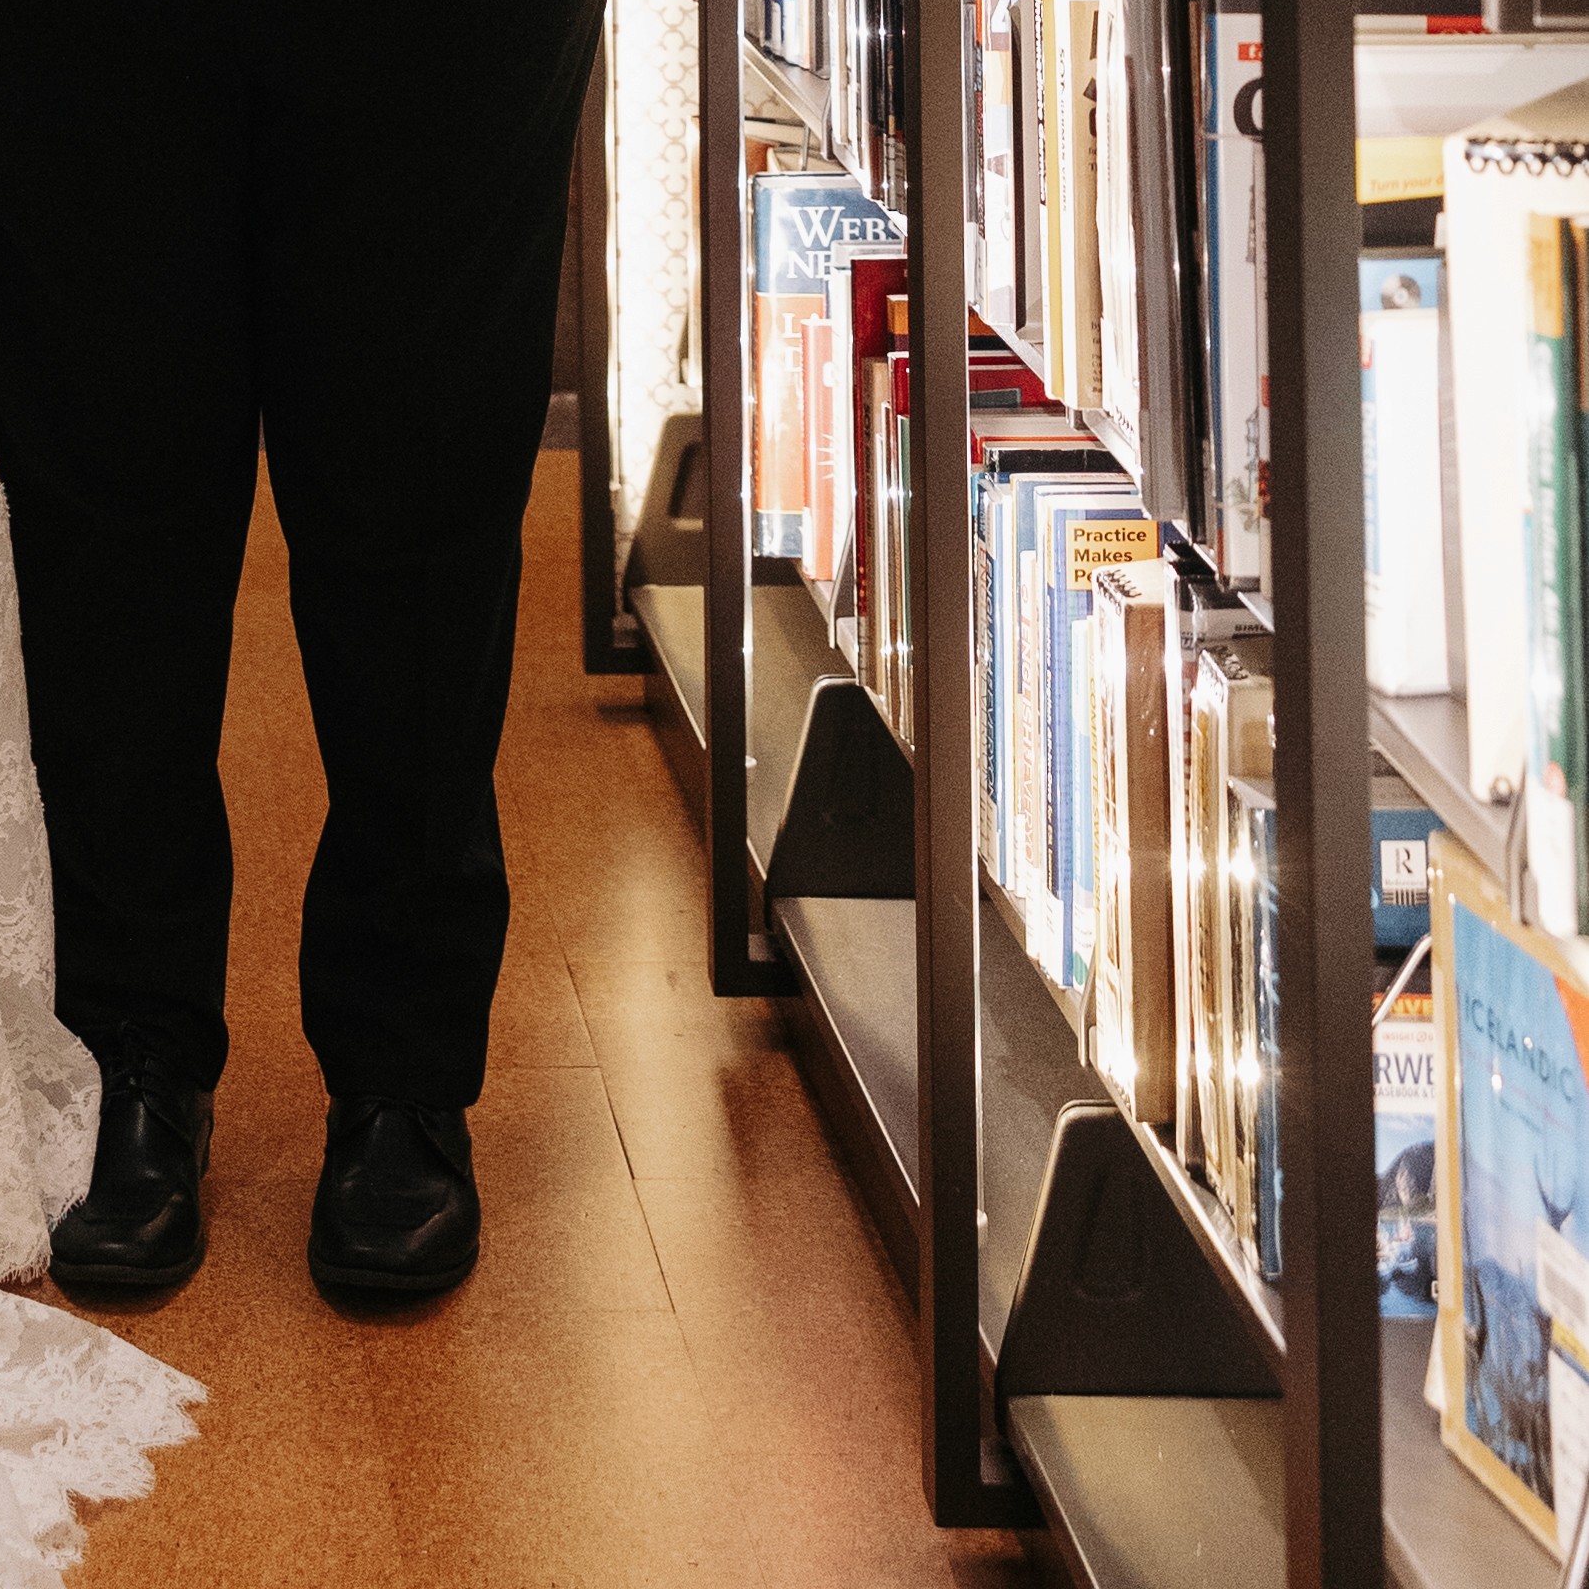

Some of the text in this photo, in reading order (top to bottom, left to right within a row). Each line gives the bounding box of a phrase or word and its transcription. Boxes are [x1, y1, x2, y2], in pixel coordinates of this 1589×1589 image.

[1073, 527, 1147, 543] Practice
[1073, 548, 1133, 564] Makes
[1022, 623, 1032, 747] ENGLISH
[1088, 677, 1102, 912] COMPLETE SWEDISH
[1466, 997, 1574, 1103] ICELANDIC
